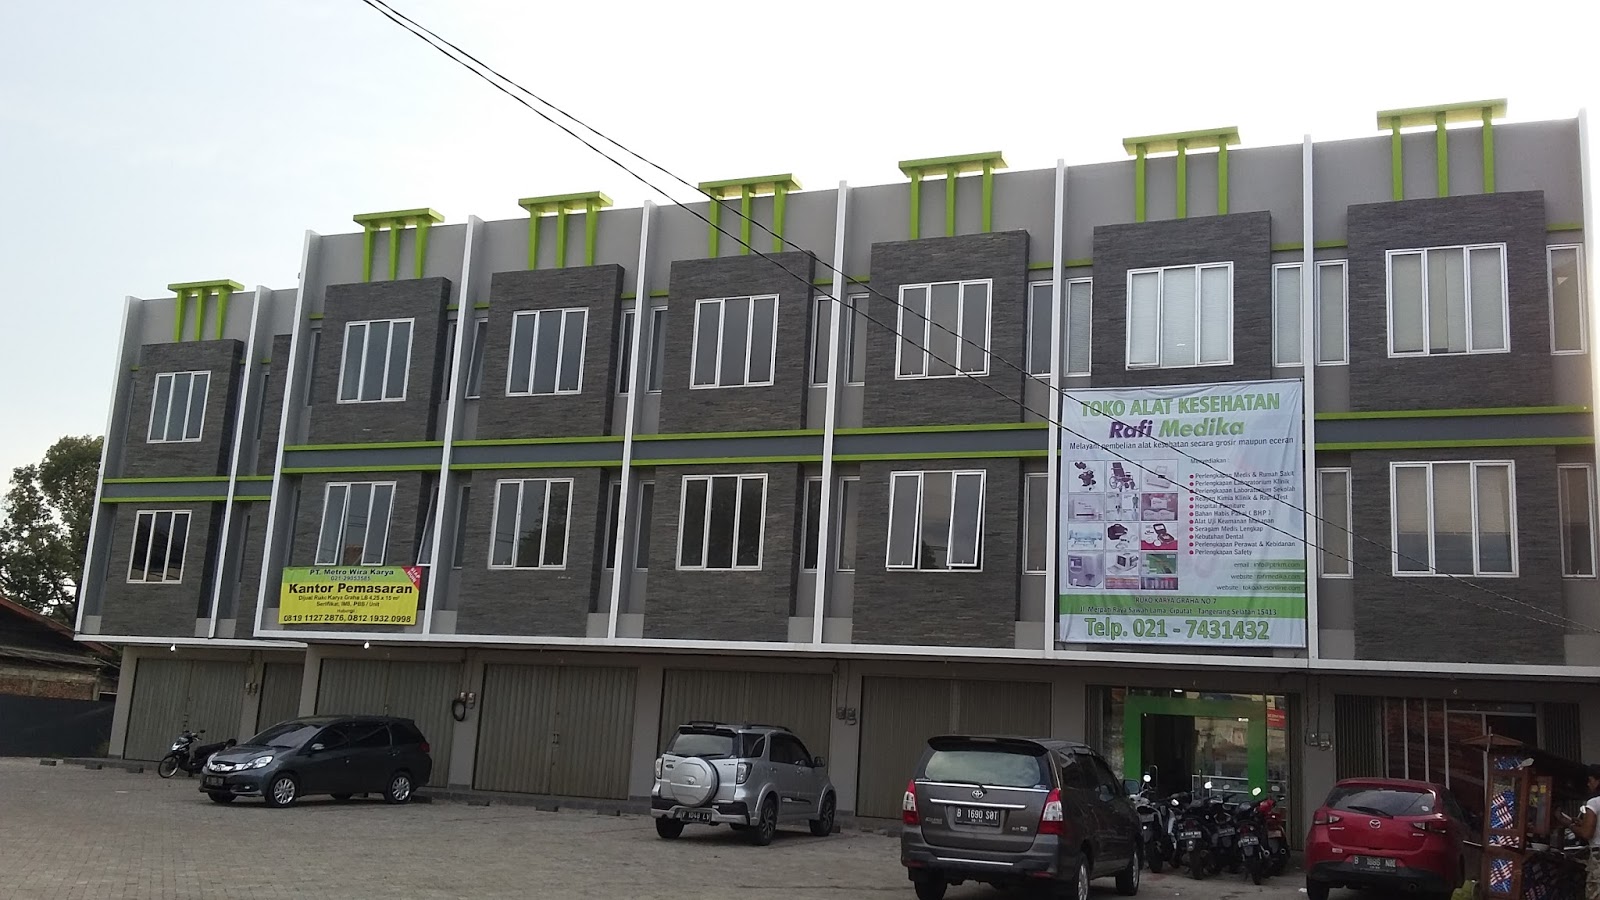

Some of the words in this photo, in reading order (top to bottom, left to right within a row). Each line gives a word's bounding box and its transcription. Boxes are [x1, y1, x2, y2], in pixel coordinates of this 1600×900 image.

[1082, 400, 1126, 417] TOKO
[1130, 398, 1173, 416] ALAT
[1178, 393, 1280, 414] KESEHATAN
[1109, 419, 1153, 439] Rafi
[1158, 417, 1244, 438] Medika
[1138, 440, 1152, 449] alat
[1190, 440, 1214, 448] secara
[1215, 439, 1237, 448] grosir
[1238, 438, 1268, 446] maupun
[1269, 437, 1294, 445] eceran
[289, 583, 334, 594] Kantor
[337, 583, 413, 594] Pemasaran
[1084, 617, 1128, 640] Telp.
[1132, 619, 1168, 638] 021
[1185, 619, 1270, 640] 7431432
[956, 809, 962, 818] B
[967, 810, 983, 819] 1690
[1354, 856, 1359, 865] B
